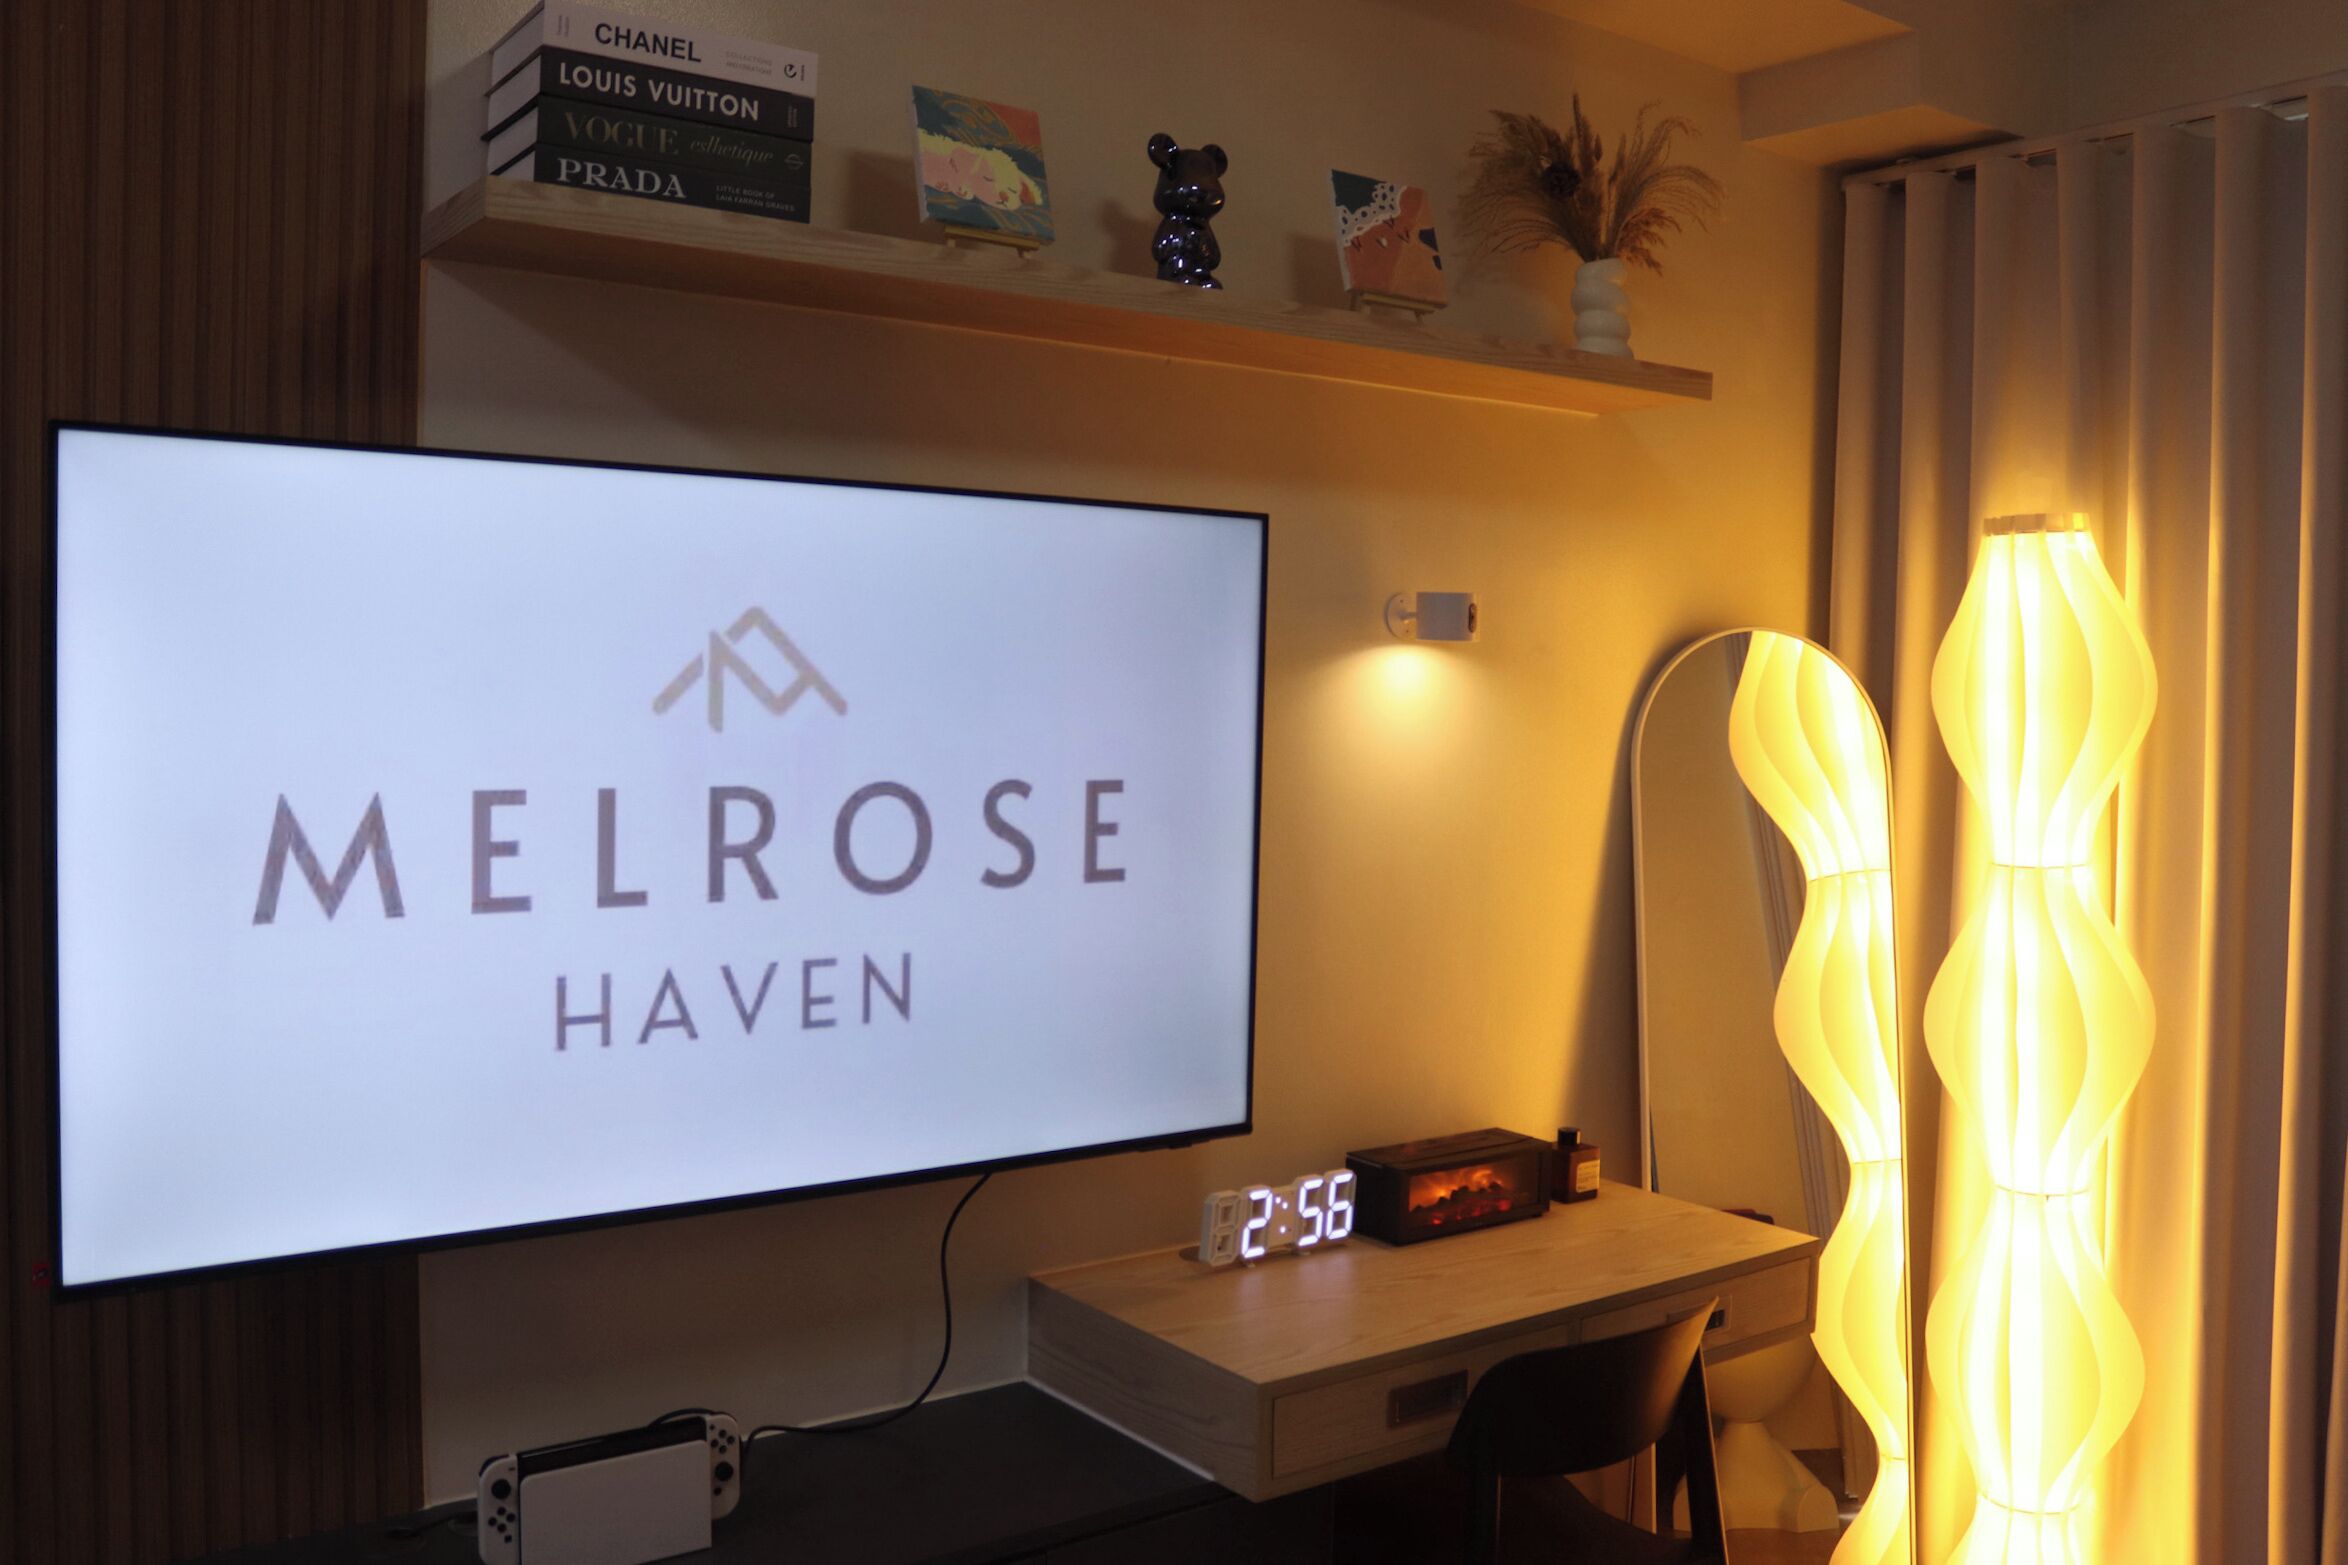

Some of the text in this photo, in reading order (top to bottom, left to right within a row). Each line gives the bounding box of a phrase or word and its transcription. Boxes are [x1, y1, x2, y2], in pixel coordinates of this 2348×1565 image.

[595, 22, 702, 63] CHANEL
[560, 61, 637, 97] LOUIS
[648, 79, 760, 122] VUITTON
[565, 111, 679, 156] VOGUE
[557, 157, 687, 199] PRADA
[252, 779, 1127, 926] MELROSE
[555, 952, 912, 1052] HAVEN
[1241, 1172, 1356, 1259] 2:56
